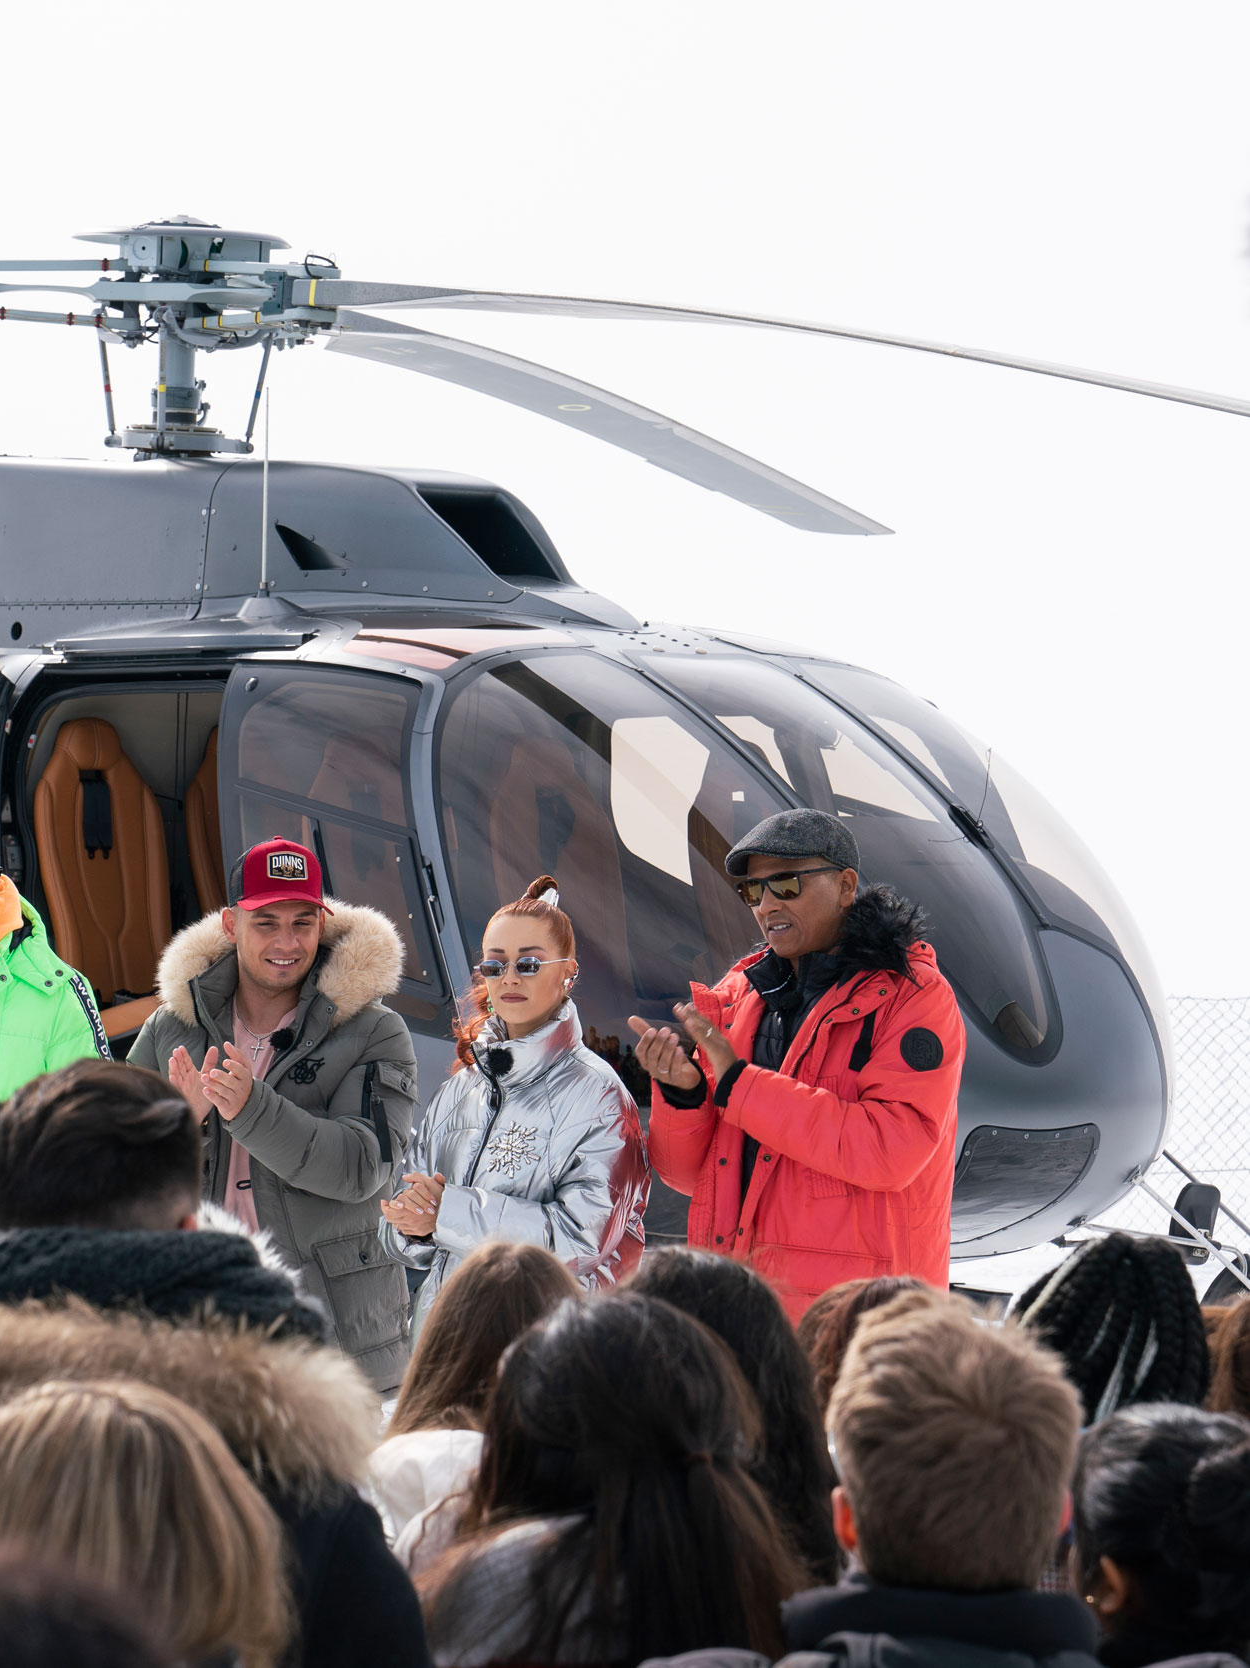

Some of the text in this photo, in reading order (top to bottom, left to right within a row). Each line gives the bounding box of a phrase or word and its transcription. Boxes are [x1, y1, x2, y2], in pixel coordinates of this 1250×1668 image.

[272, 855, 304, 871] DJINNS
[72, 974, 88, 996] EW
[86, 998, 106, 1041] CAMP
